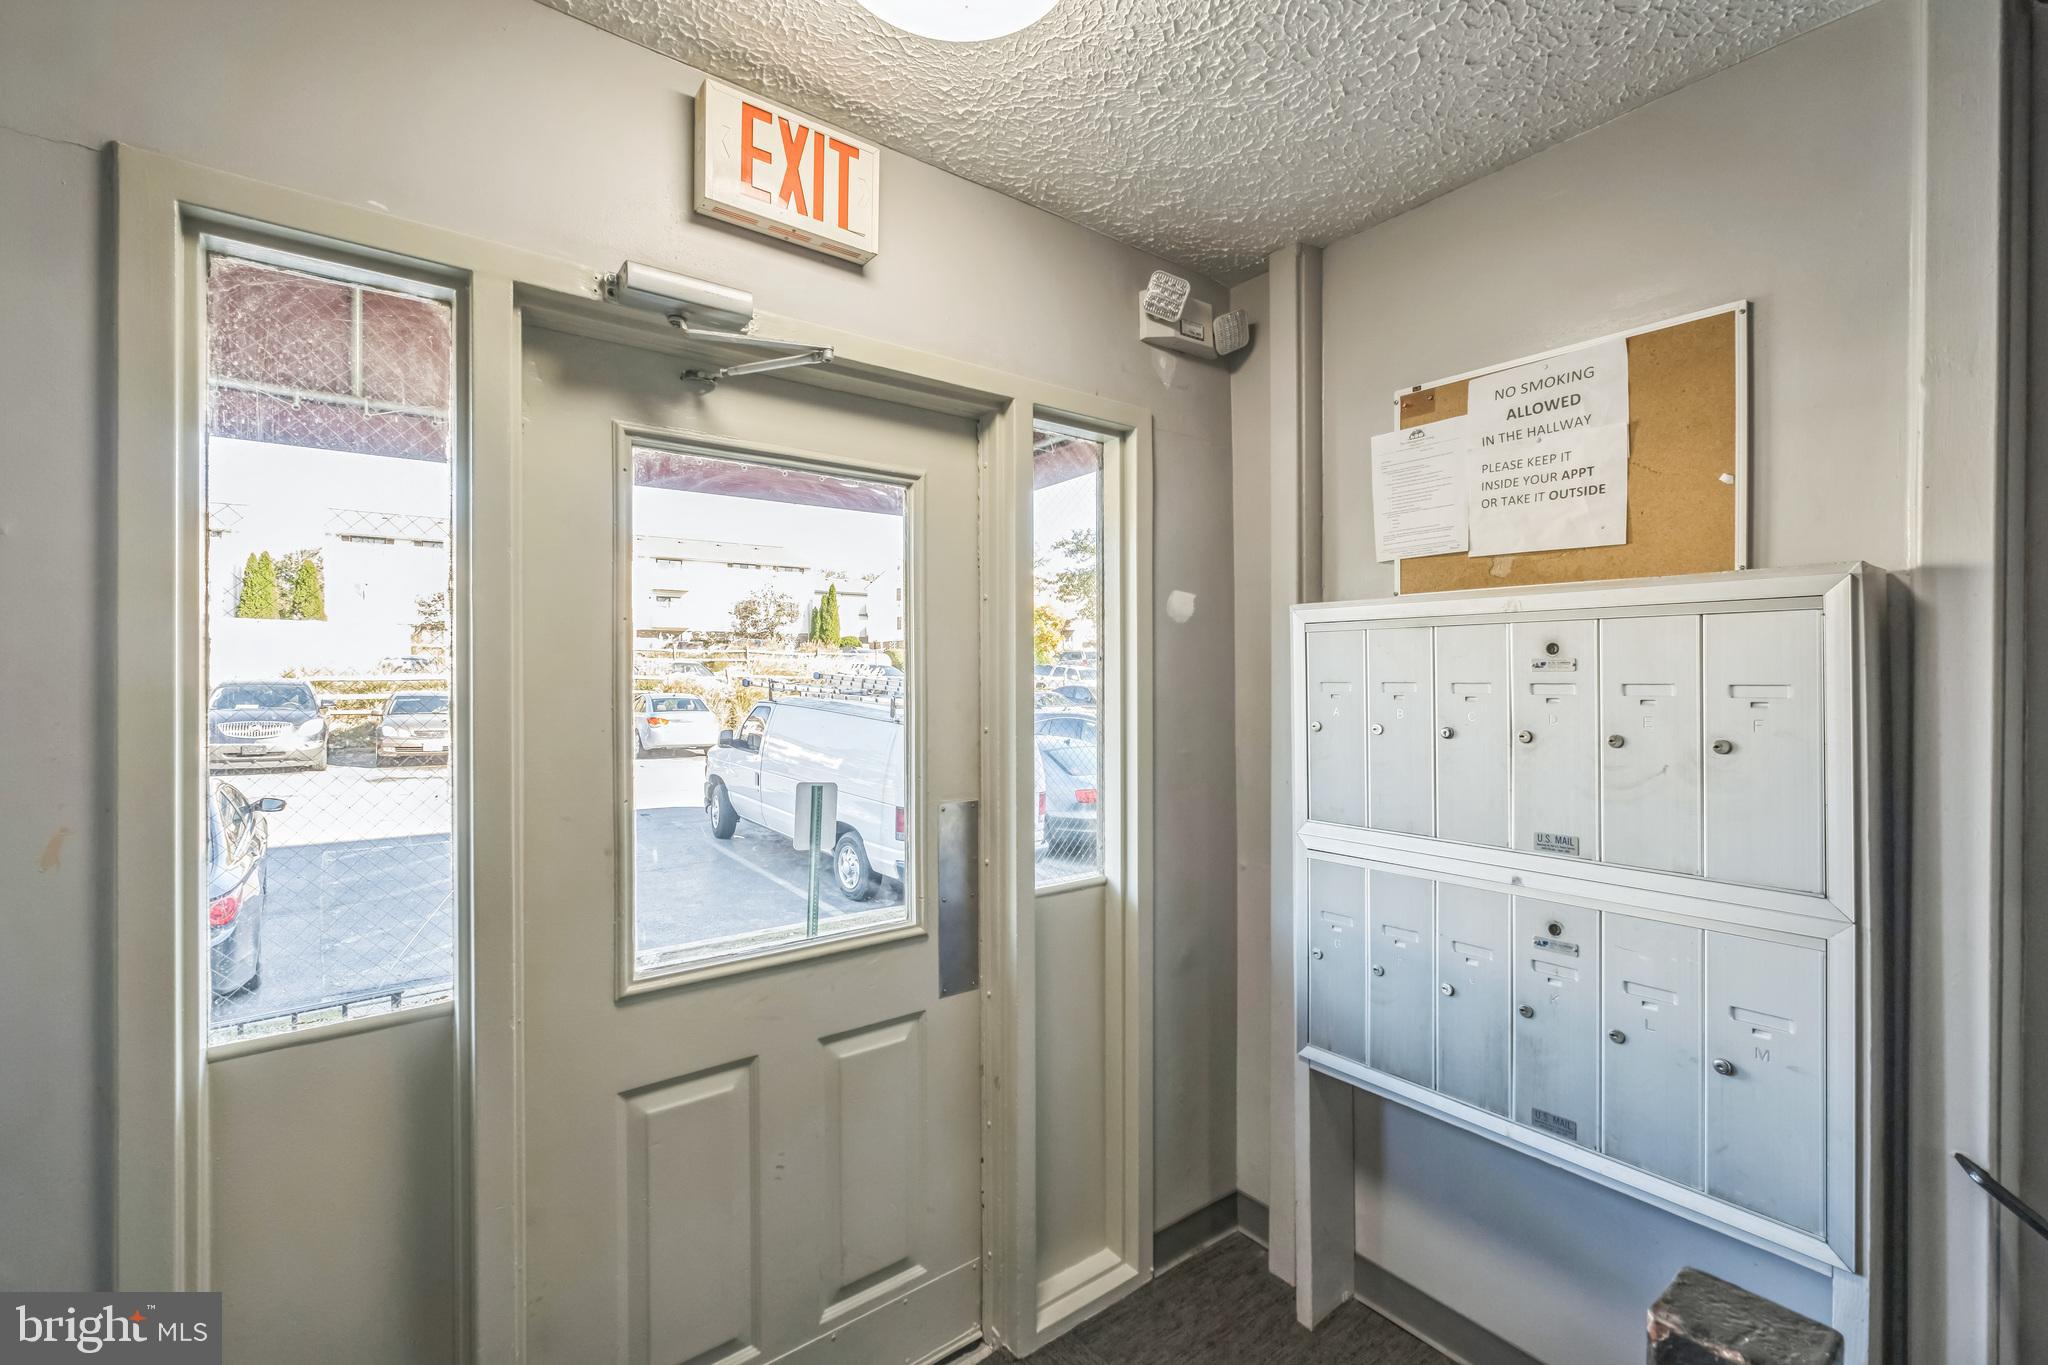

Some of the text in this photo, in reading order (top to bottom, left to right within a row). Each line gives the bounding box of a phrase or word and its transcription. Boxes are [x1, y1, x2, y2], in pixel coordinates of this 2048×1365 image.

[741, 101, 860, 230] EXIT
[1494, 366, 1595, 401] NO SMOKING
[1506, 393, 1581, 421] ALLOWED
[1482, 413, 1592, 447] IN THE HALLWAY
[1481, 450, 1573, 474] PLEASE KEEP IT
[1481, 466, 1595, 492] INSIDE YOUR APPT
[1481, 483, 1607, 509] OR TAKE IT OUTSIDE
[1332, 707, 1341, 717] A
[1396, 709, 1405, 720] B
[1467, 711, 1478, 722] C
[1643, 715, 1653, 729] E
[1754, 719, 1764, 733] F
[1555, 835, 1574, 846] MAIL
[1645, 1018, 1656, 1032] L
[1754, 1047, 1770, 1063] M
[1553, 1115, 1572, 1130] MAIL
